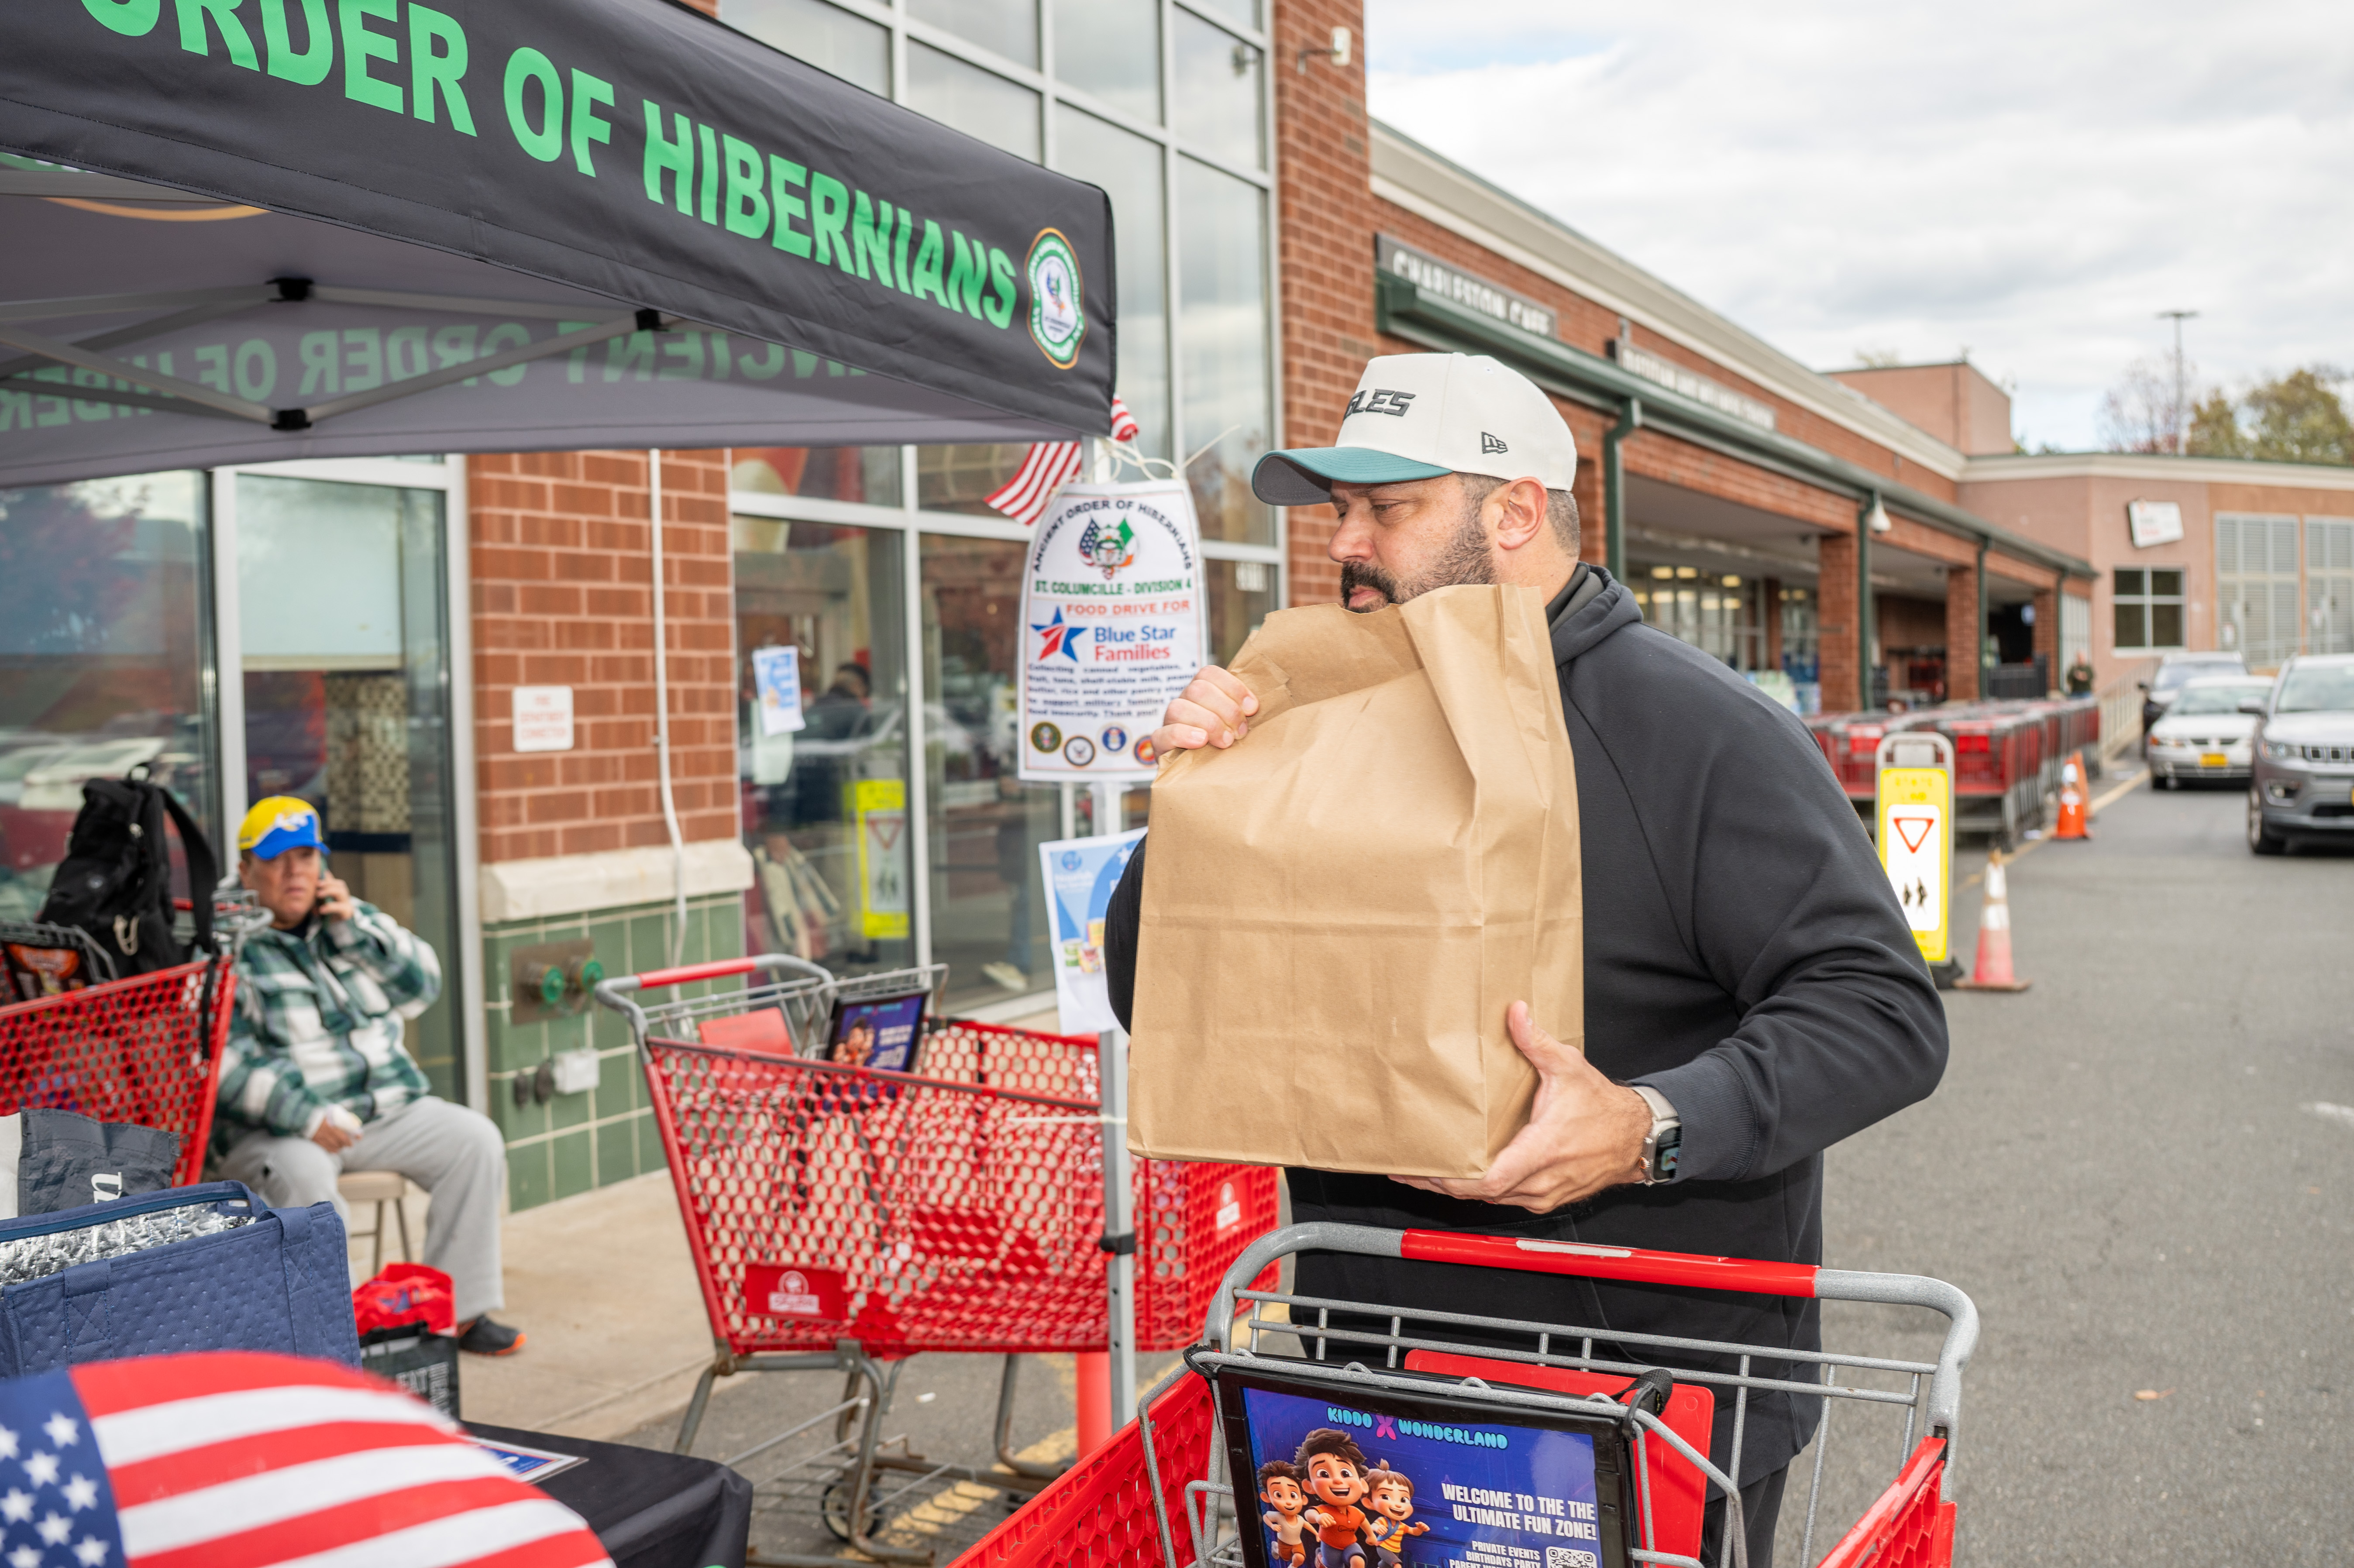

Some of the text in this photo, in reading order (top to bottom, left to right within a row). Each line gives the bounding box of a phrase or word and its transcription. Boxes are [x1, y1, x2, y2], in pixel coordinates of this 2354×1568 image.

[503, 47, 615, 177] OF
[643, 99, 1017, 329] HIBERNIANS
[1066, 499, 1111, 519] ORDER
[1116, 500, 1135, 510] OF
[1137, 503, 1192, 571] HIBERNIANS
[1034, 580, 1048, 593] ST.
[1051, 581, 1124, 595] COLUMCILLE
[1135, 580, 1182, 594] DIVISION
[1186, 578, 1192, 588] 4
[1066, 599, 1190, 616] FOOD DRIVE FOR
[1094, 625, 1176, 643] Blue Star
[1095, 643, 1171, 661] Families
[1327, 1406, 1373, 1428] KIDDO
[1398, 1418, 1508, 1450] WONDERLAND
[1442, 1483, 1596, 1520] WELCOME TO THE THE
[1452, 1504, 1597, 1540] ULTIMATE FUN ZONE!
[1466, 1551, 1541, 1568] BIRTHDAYS PARTY
[1472, 1540, 1541, 1561] PRIVATE EVENTS
